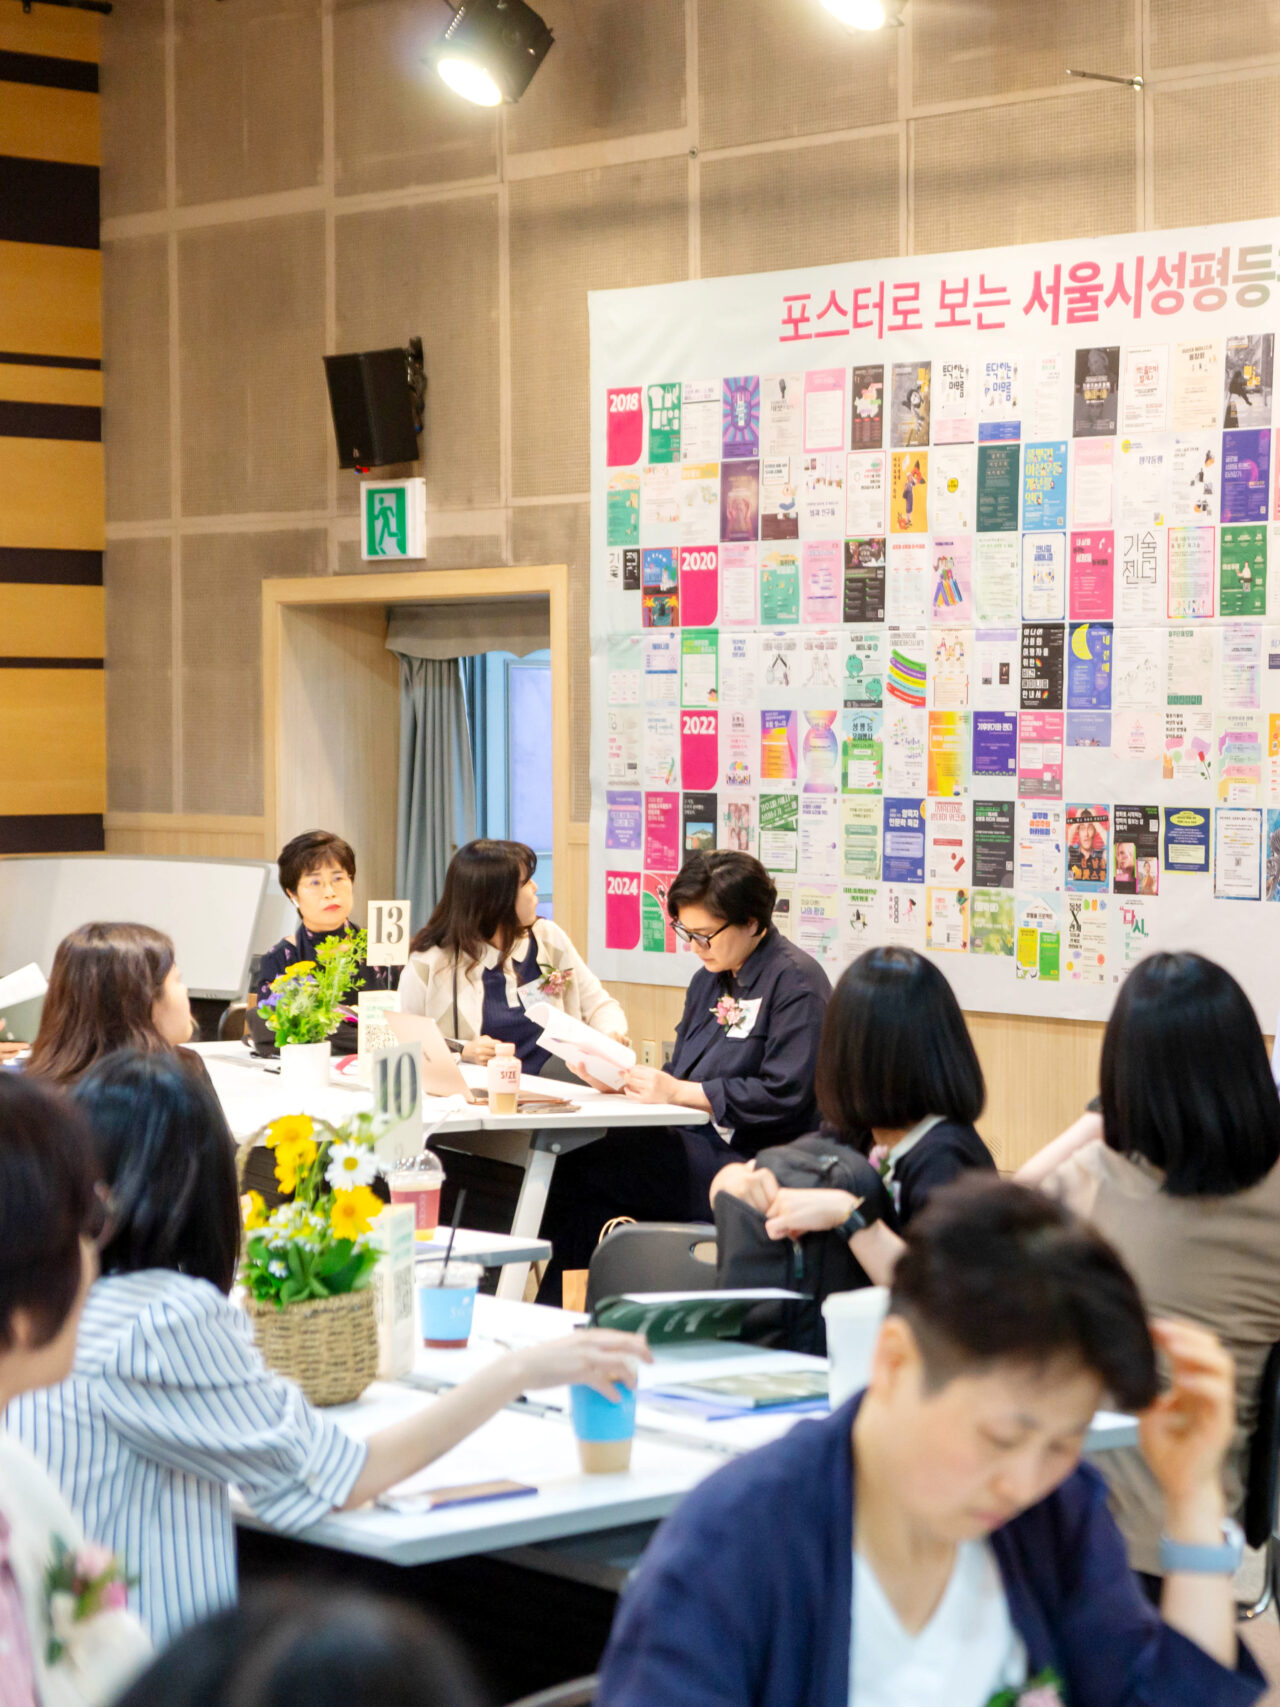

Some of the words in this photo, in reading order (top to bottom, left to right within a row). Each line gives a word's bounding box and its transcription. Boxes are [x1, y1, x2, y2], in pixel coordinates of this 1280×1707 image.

[778, 280, 923, 343] 포스터로
[934, 273, 1011, 331] 보는
[609, 394, 640, 412] 2018
[1123, 531, 1157, 559] 기술
[681, 551, 717, 571] 2020
[1122, 558, 1157, 584] 젠더
[683, 716, 716, 735] 2022
[607, 876, 638, 896] 2024
[373, 906, 404, 945] 13
[376, 1052, 418, 1122] 10
